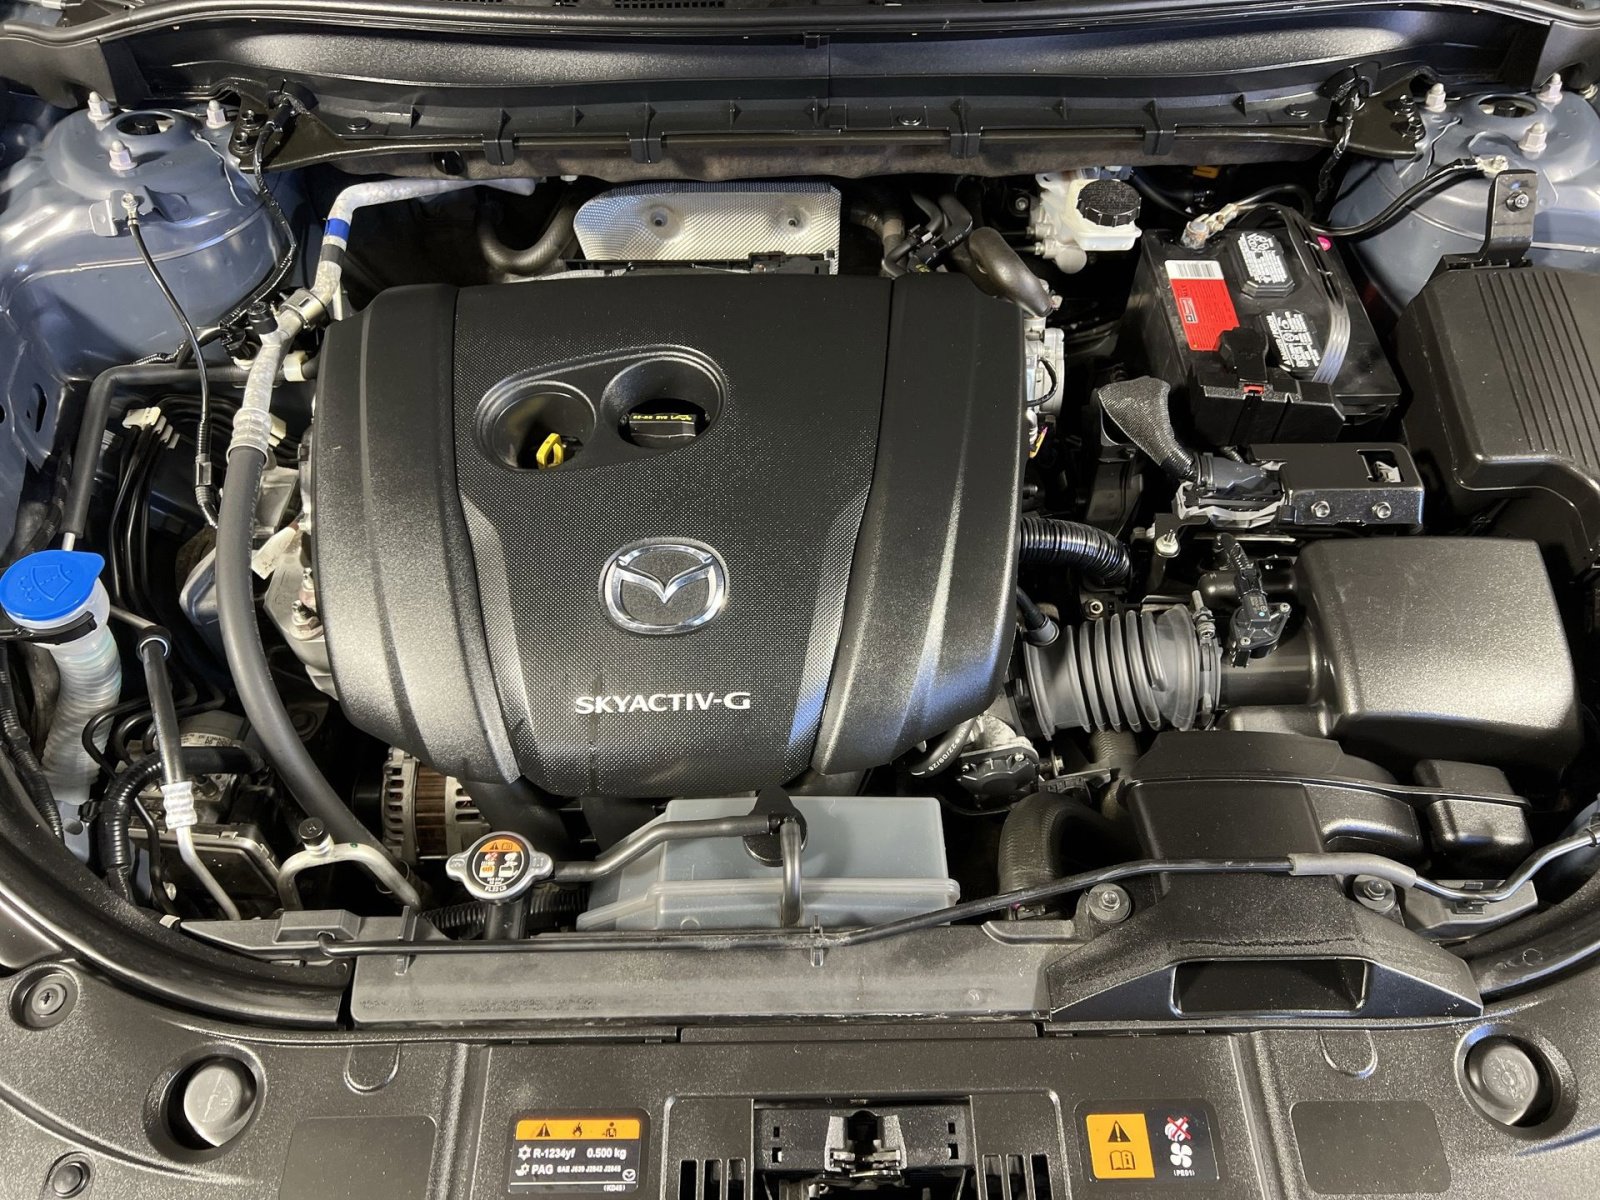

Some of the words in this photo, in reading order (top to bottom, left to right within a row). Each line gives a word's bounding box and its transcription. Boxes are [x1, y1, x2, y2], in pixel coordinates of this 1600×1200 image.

[574, 691, 751, 715] SKYACTIV-G
[532, 1147, 576, 1160] R-1234yf
[586, 1147, 612, 1159] 0.500
[613, 1147, 627, 1160] kg
[531, 1164, 554, 1175] PAG
